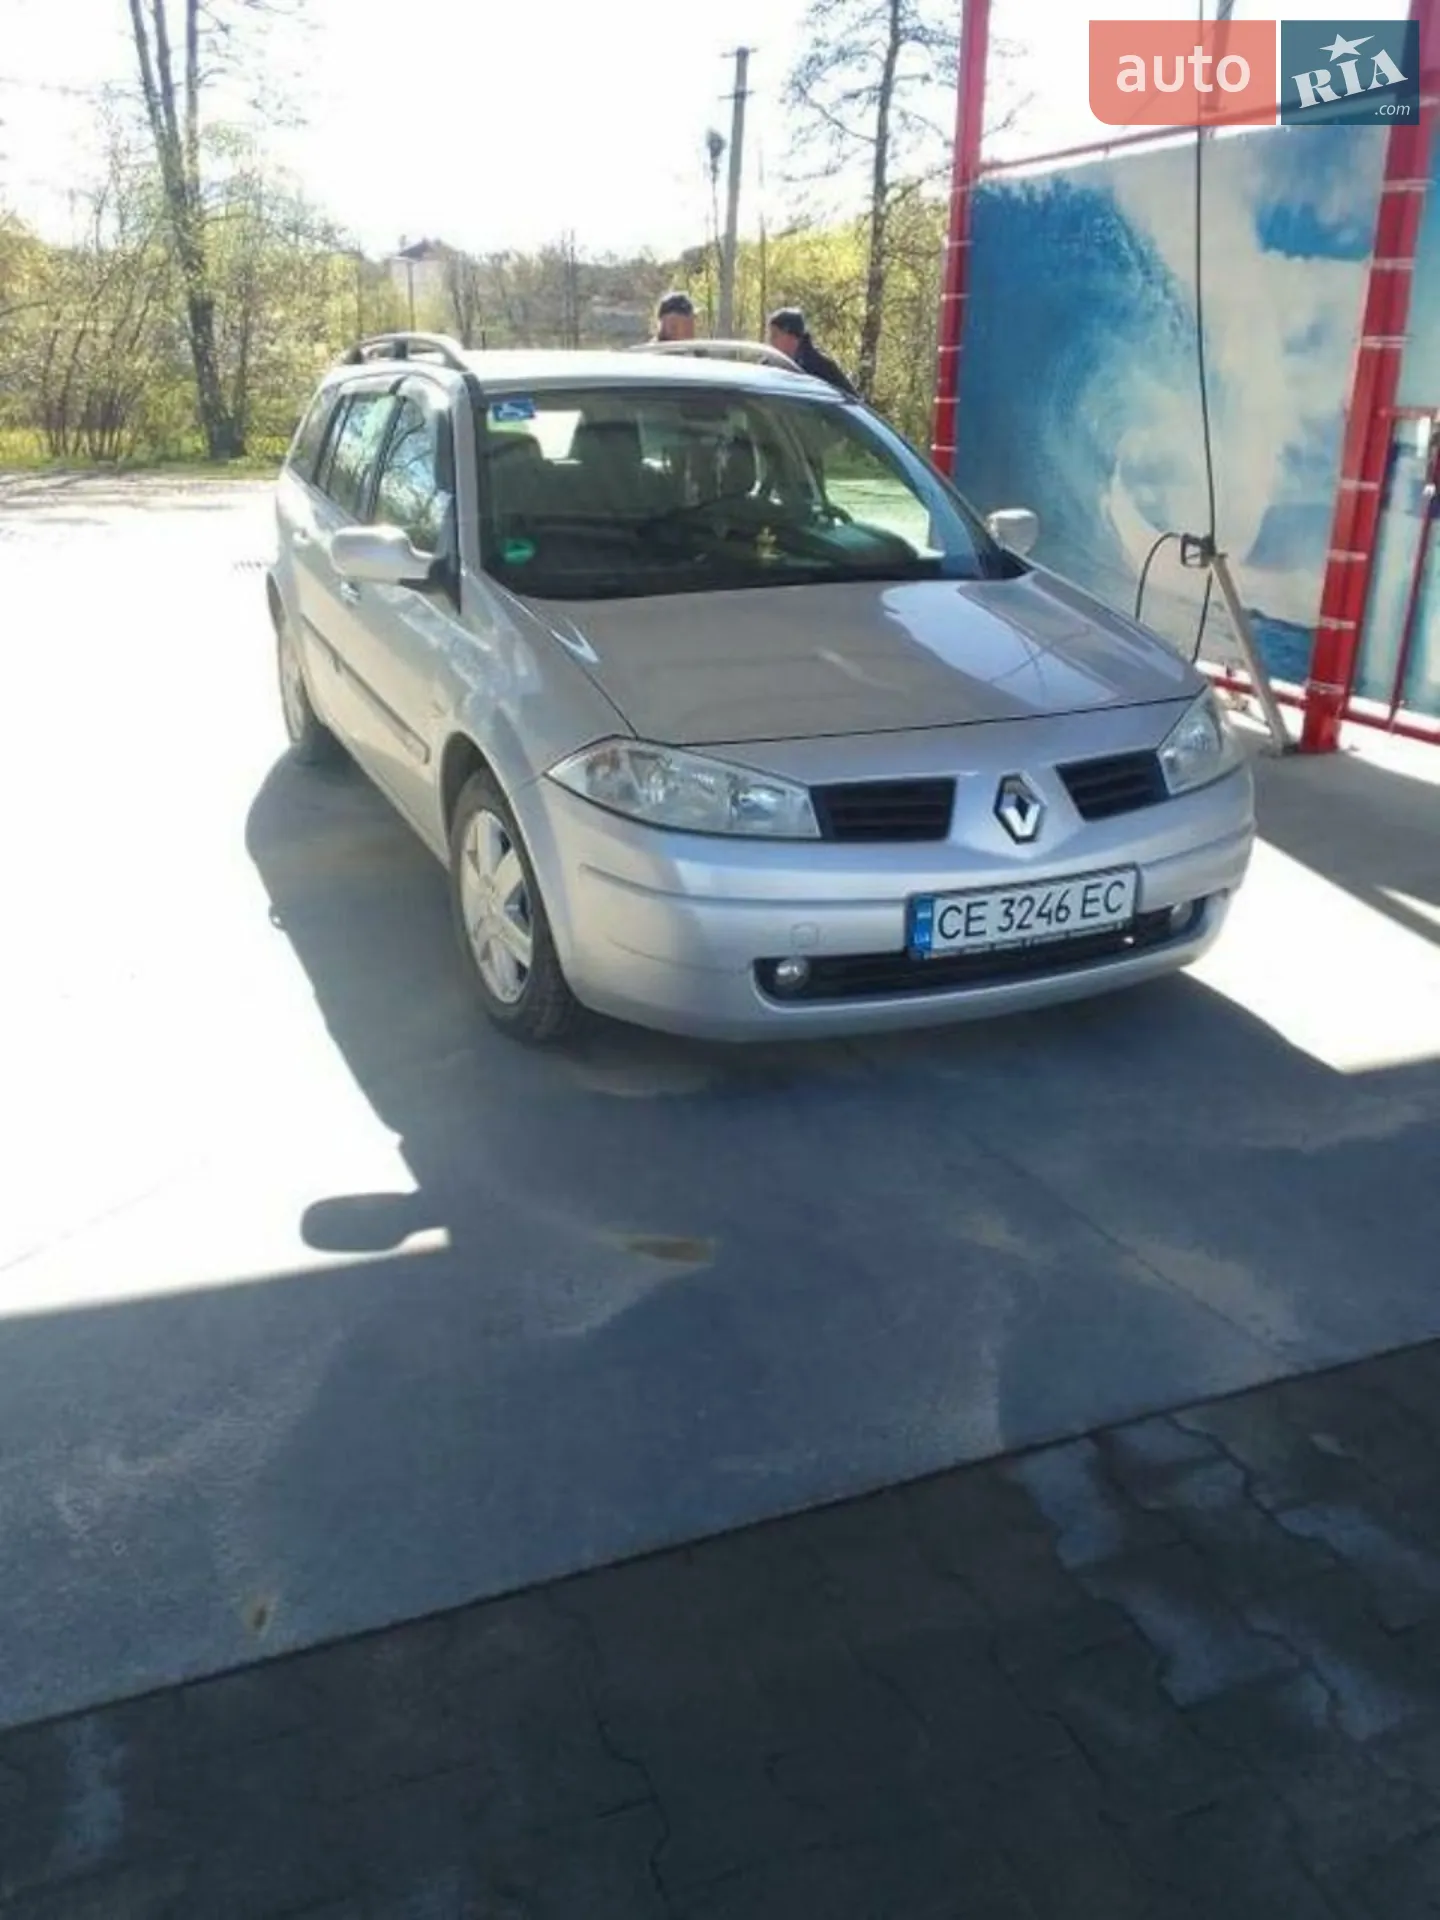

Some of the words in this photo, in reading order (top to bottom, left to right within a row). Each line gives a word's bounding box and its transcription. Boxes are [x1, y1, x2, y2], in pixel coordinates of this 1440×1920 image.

[937, 900, 989, 940] CE
[997, 889, 1072, 933] 3246
[1080, 880, 1126, 920] EC
